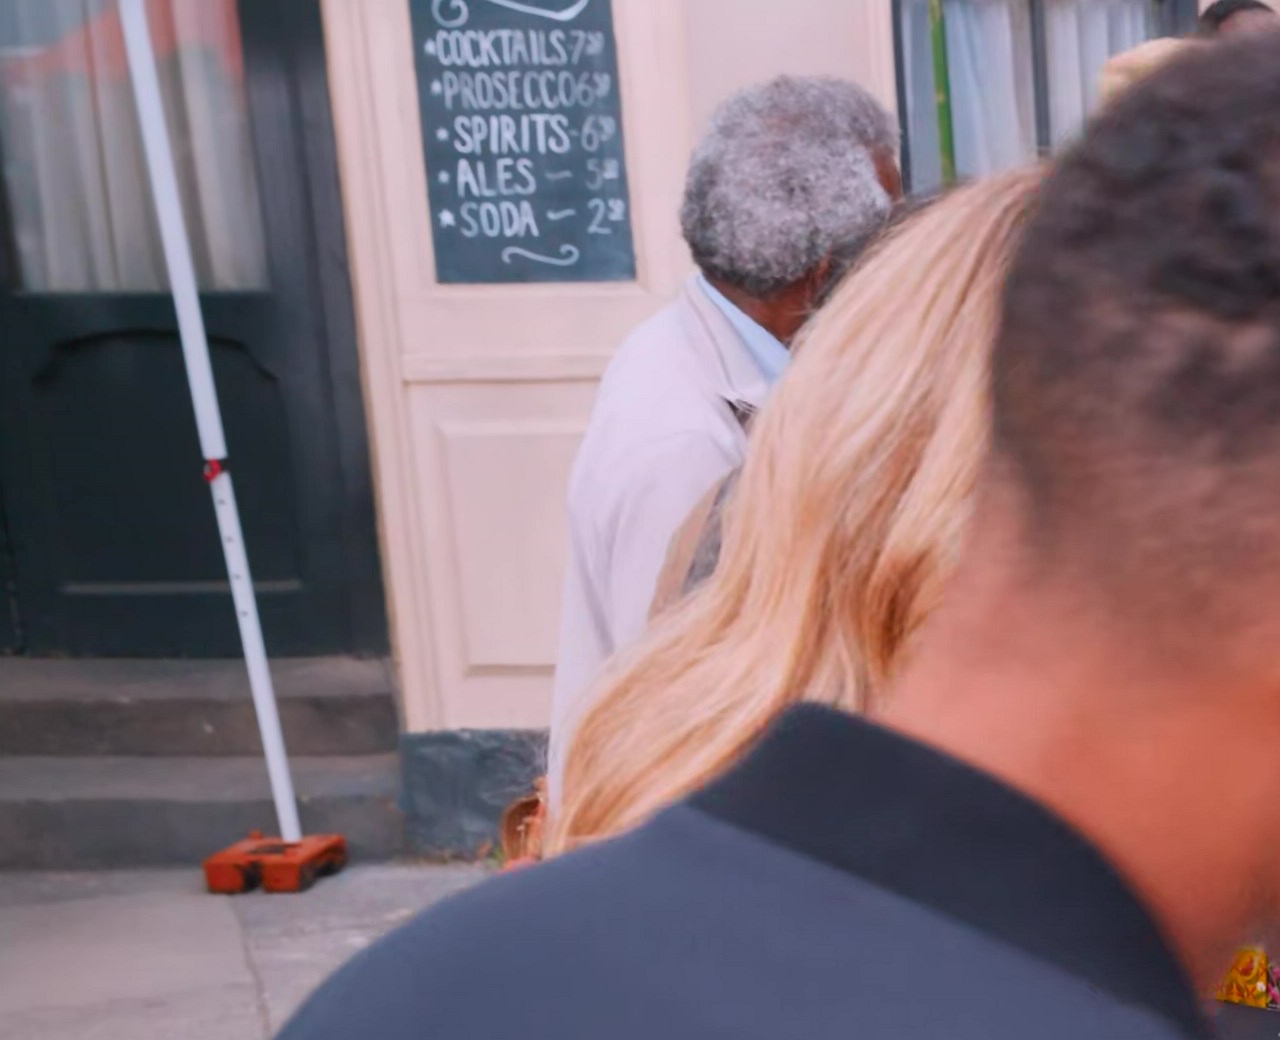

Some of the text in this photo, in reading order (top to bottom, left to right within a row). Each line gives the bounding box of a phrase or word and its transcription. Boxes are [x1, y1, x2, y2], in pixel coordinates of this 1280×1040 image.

[437, 29, 569, 67] COCKTAILS
[443, 71, 574, 110] PROSECCO
[454, 114, 570, 154] SPIRITS
[457, 158, 536, 197] ALES
[460, 201, 539, 237] SODA
